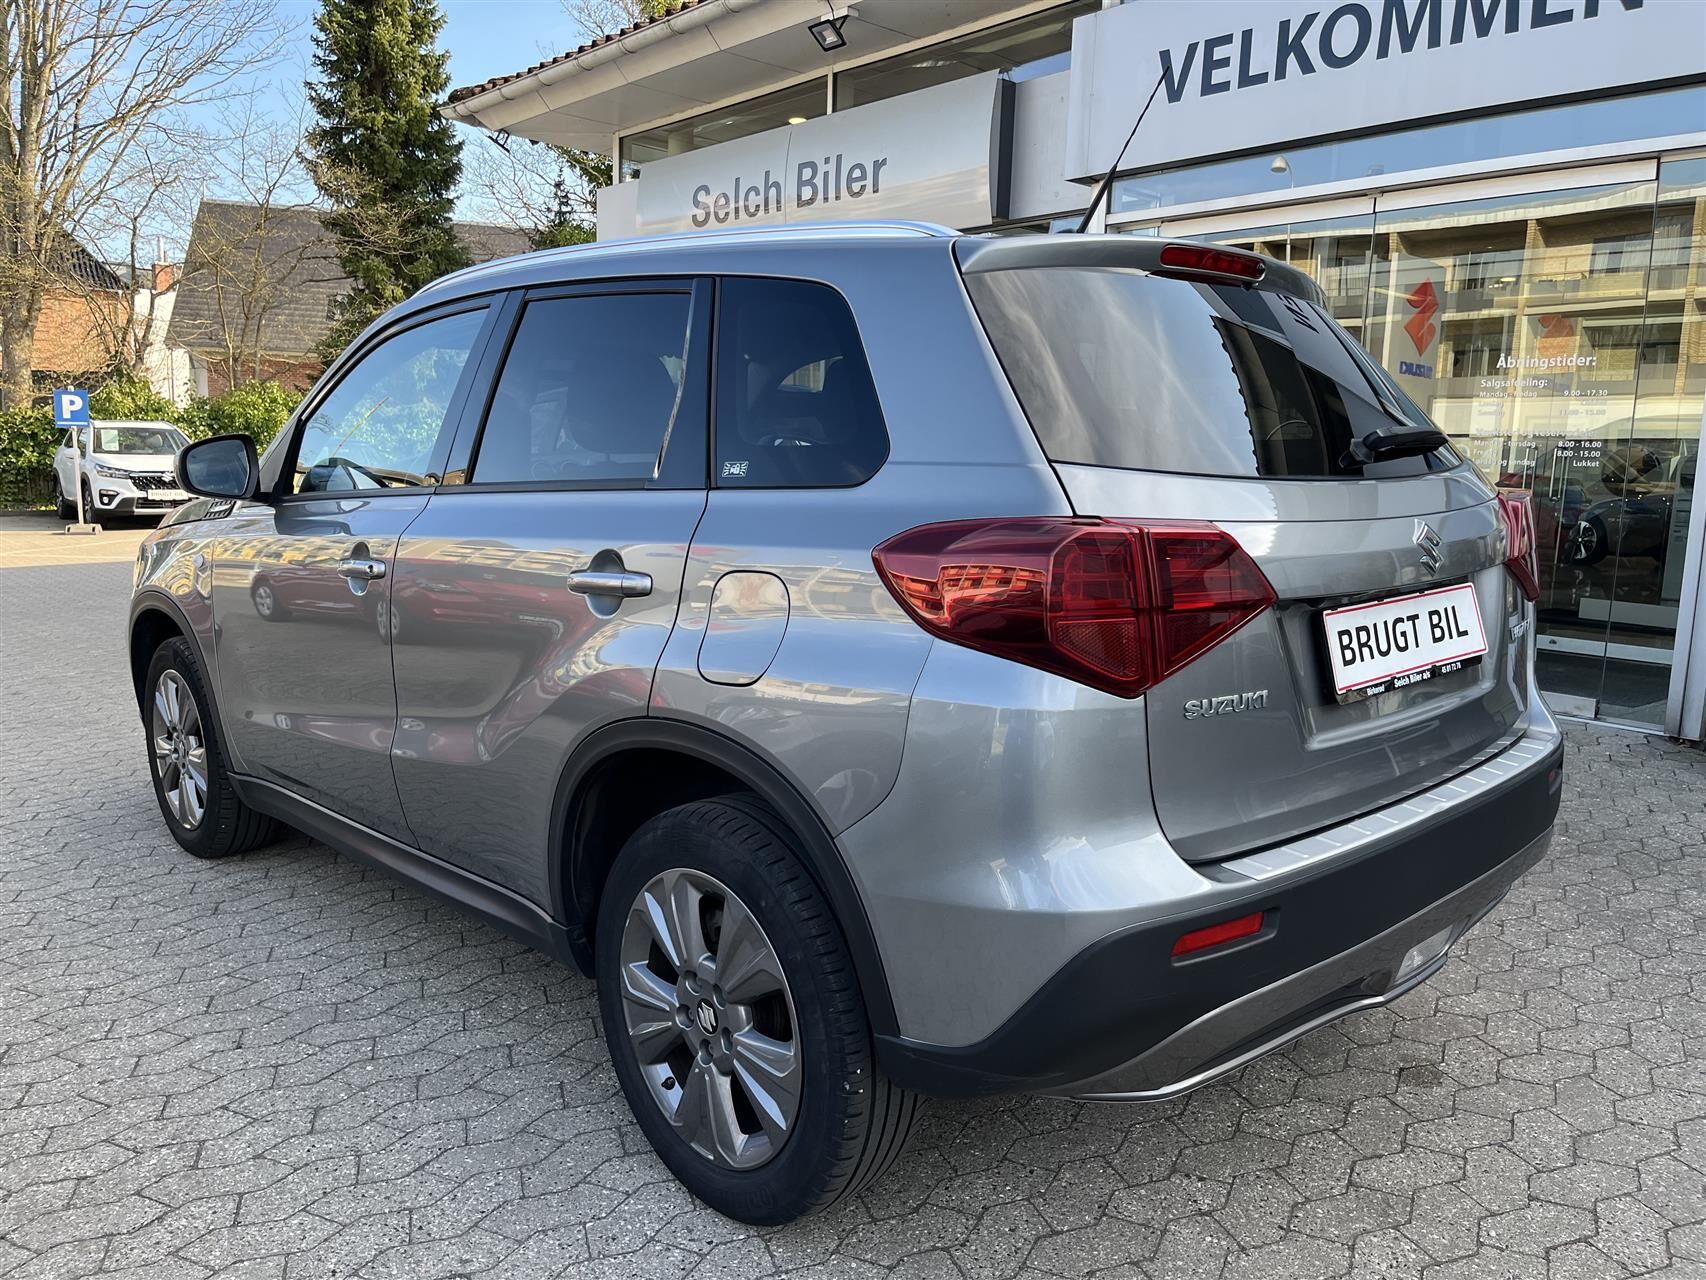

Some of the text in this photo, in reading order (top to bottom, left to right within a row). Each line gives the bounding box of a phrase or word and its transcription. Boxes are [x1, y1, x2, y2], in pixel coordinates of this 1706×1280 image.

[1158, 0, 1643, 104] VELKOMM
[691, 153, 887, 228] Selch Biler
[1496, 353, 1597, 369] Åbningstider:
[1586, 389, 1608, 397] 17.30
[62, 394, 83, 419] P
[1558, 440, 1575, 448] 8.00
[1580, 440, 1602, 448] 16.00
[1579, 450, 1601, 458] 15.00
[1573, 459, 1600, 467] Lukket
[1337, 613, 1420, 667] BRUGT
[1427, 605, 1469, 644] BIL
[1394, 677, 1410, 688] Selch
[1184, 690, 1269, 720] SUZUKI
